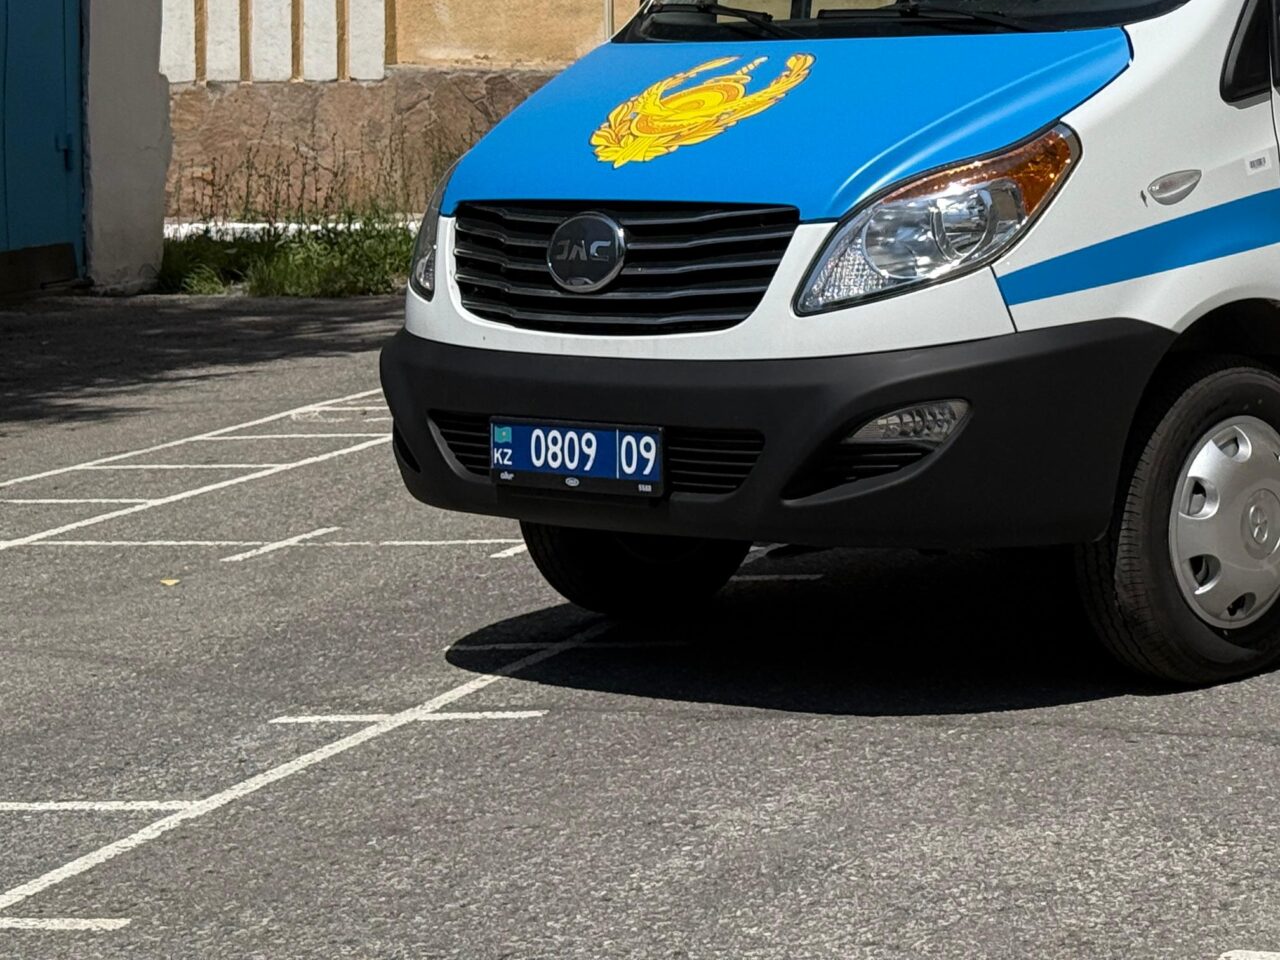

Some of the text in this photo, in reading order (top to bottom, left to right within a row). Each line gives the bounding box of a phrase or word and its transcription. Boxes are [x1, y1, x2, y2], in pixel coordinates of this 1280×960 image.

[556, 240, 612, 261] JAC
[494, 448, 513, 465] KZ
[531, 428, 657, 475] 0809 09
